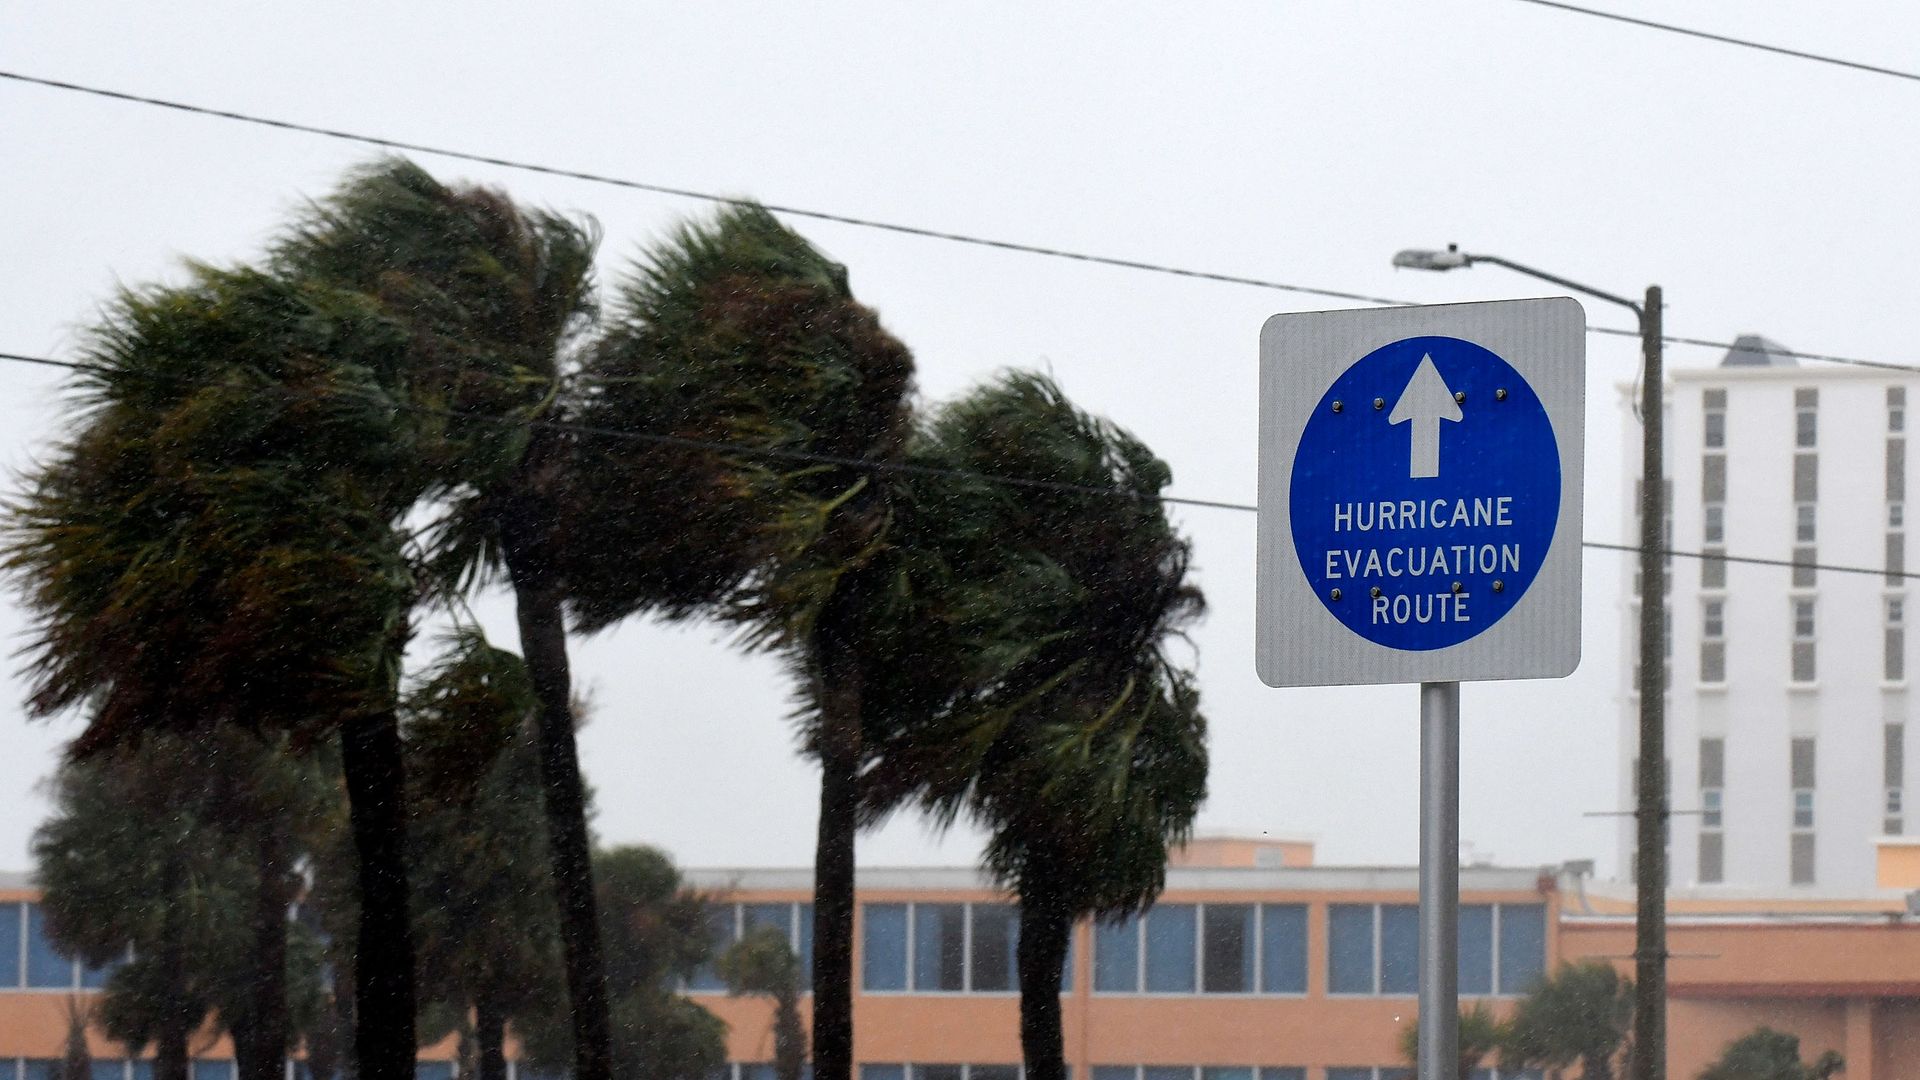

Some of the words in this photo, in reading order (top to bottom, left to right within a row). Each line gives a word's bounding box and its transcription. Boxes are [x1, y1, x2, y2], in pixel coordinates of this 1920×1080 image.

[1333, 496, 1513, 532] HURRICANE
[1326, 544, 1520, 579] EVACUATION
[1372, 592, 1470, 625] ROUTE
